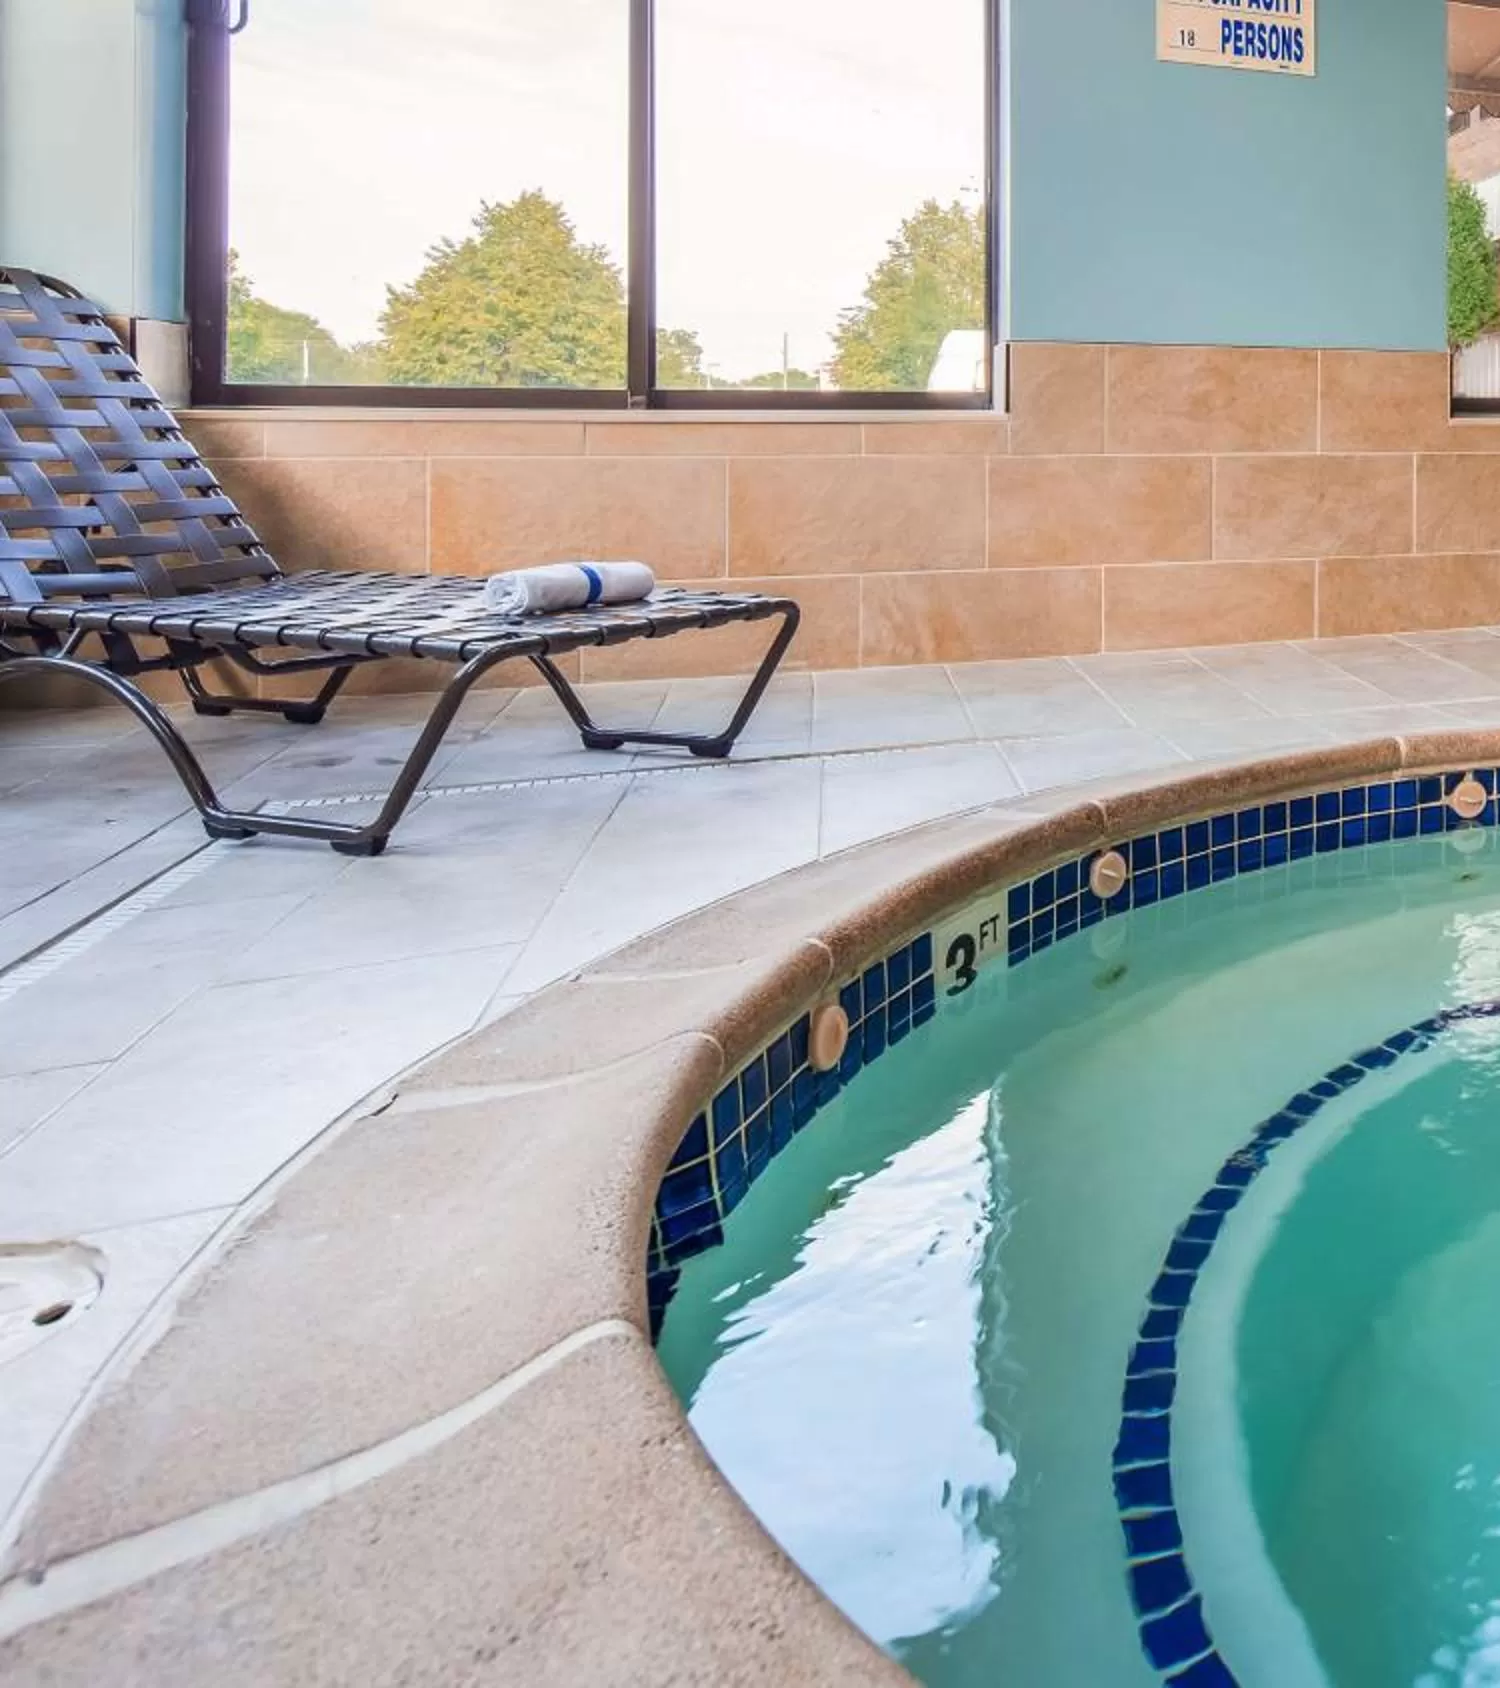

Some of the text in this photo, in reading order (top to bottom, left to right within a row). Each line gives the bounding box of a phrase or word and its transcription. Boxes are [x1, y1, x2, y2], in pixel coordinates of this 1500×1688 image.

[1179, 18, 1304, 63] 18 PERSONS
[945, 913, 999, 997] 3 FT
